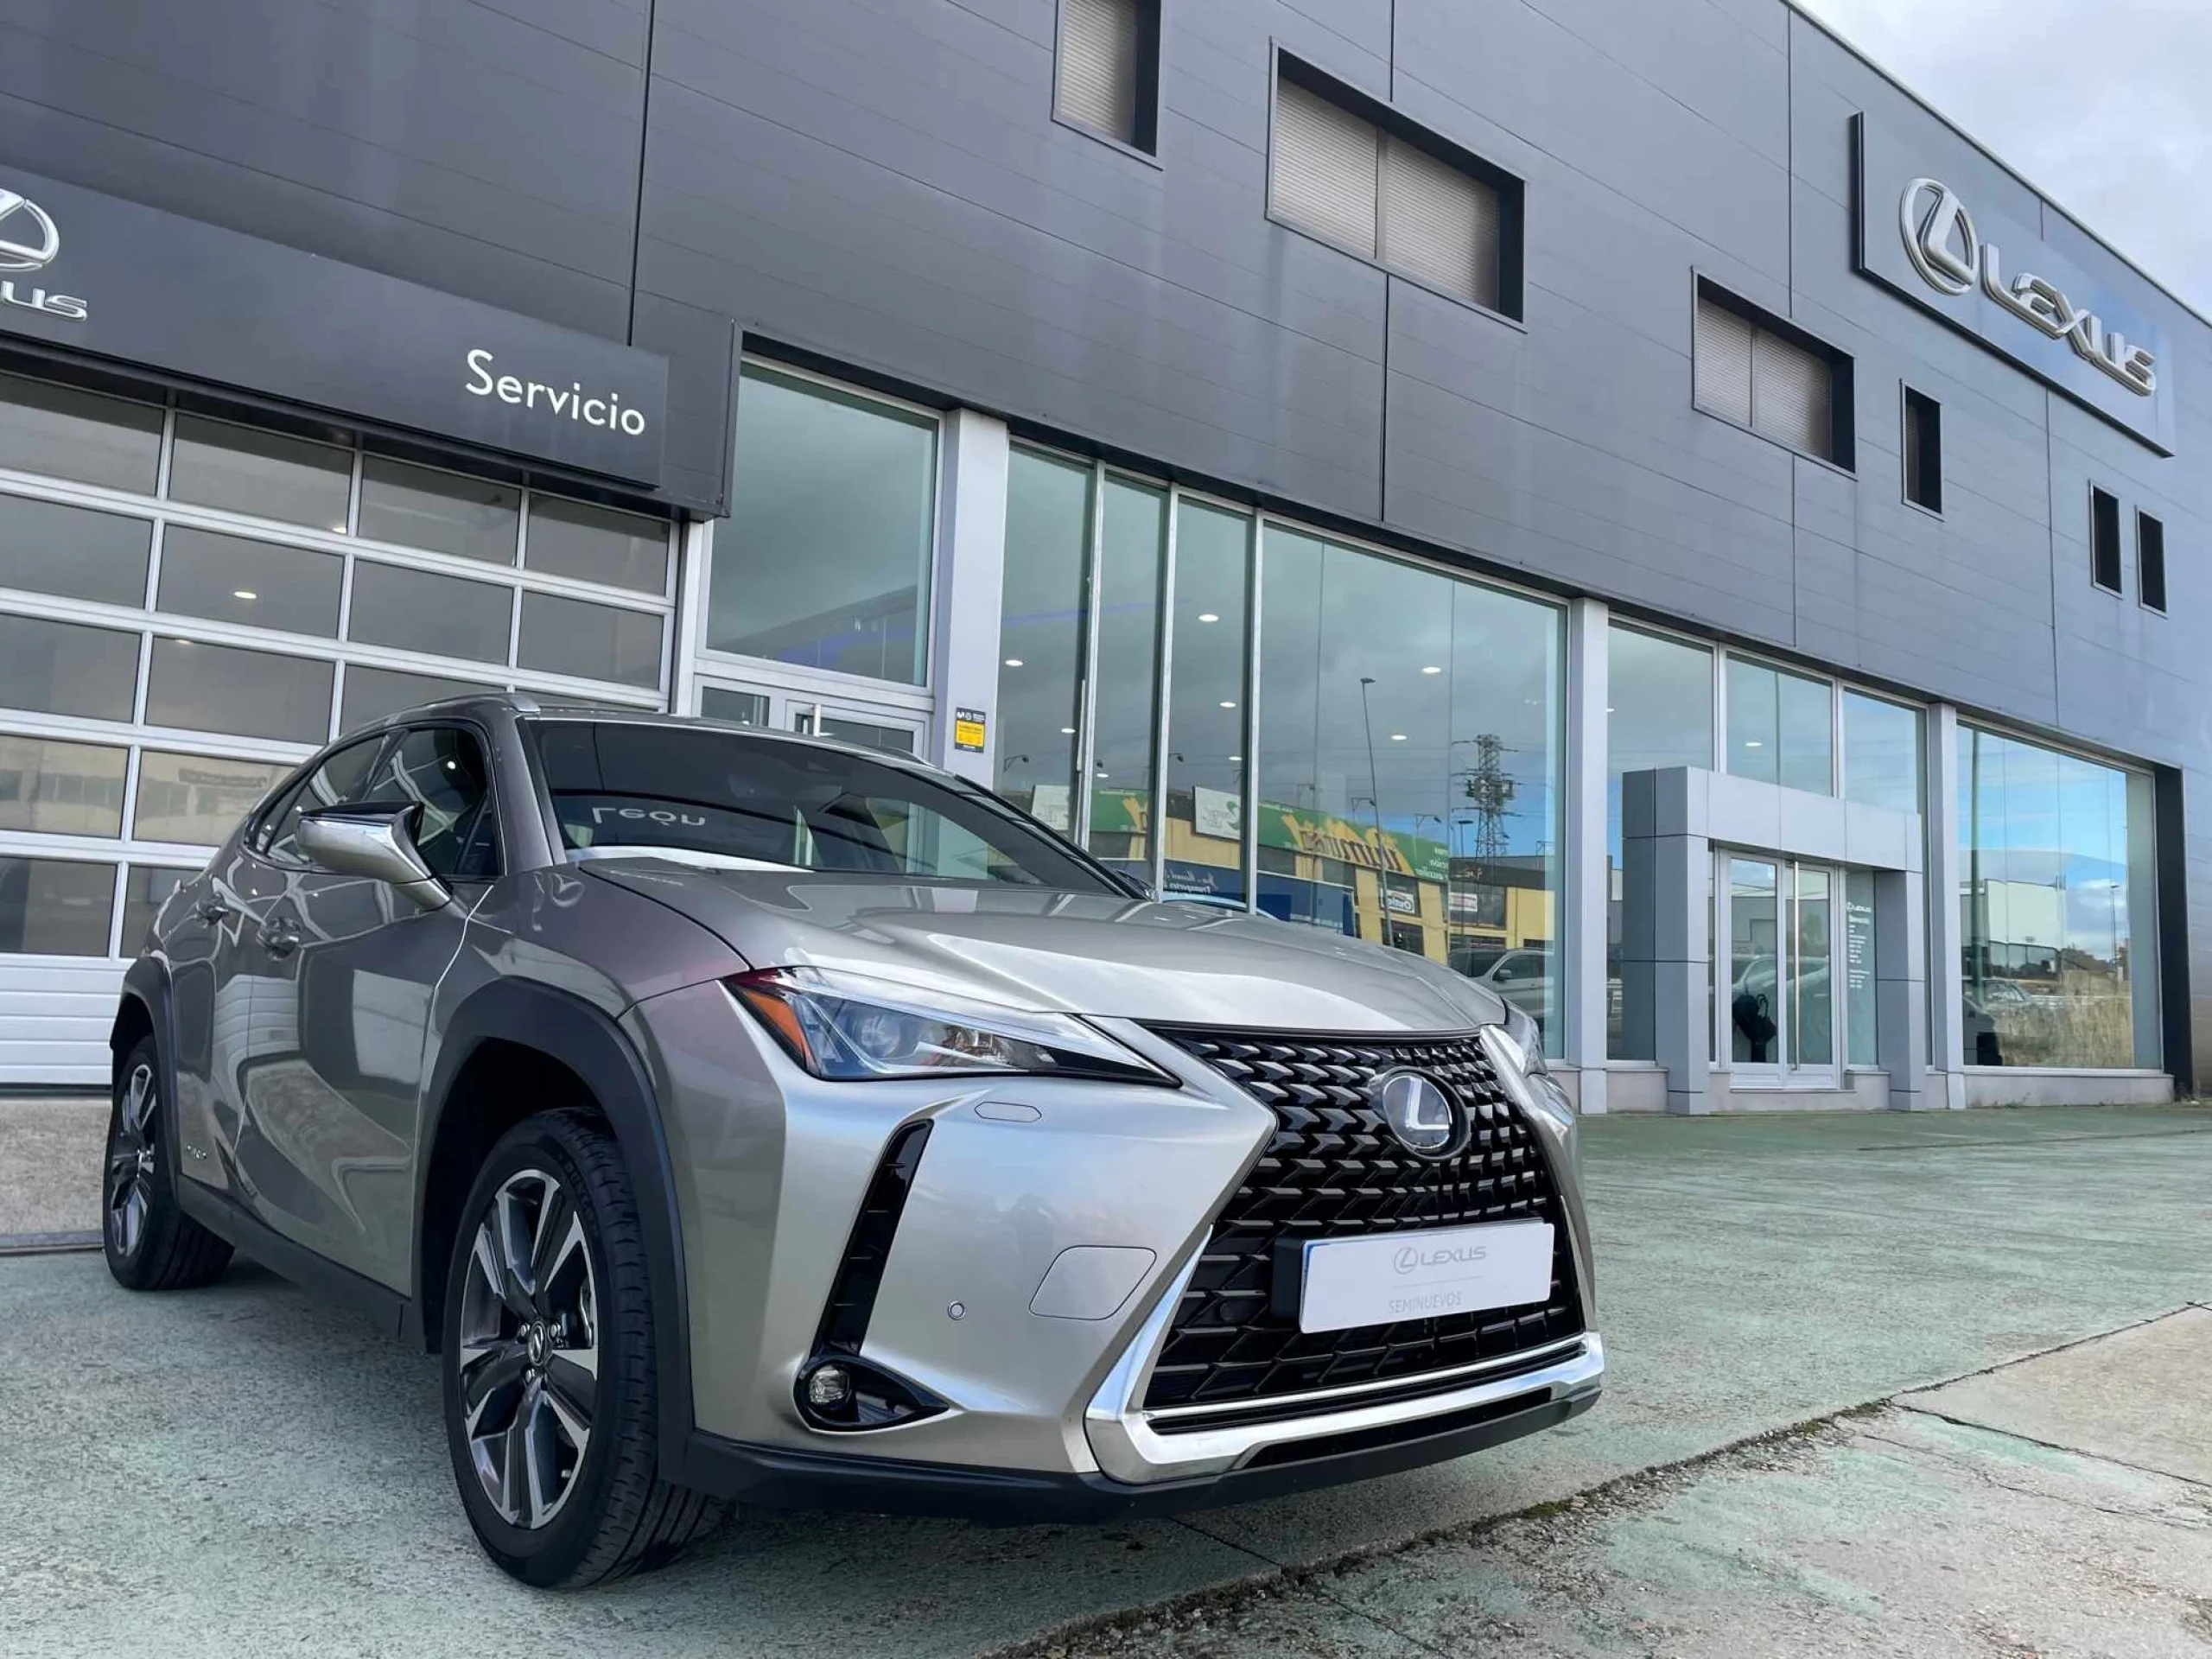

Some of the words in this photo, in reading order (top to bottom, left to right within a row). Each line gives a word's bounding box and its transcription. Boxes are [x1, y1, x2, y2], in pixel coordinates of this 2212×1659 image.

[1980, 244, 2157, 397] LEXUS
[465, 347, 647, 436] Servicio
[1420, 1245, 1487, 1267] LEXUS
[1388, 1292, 1462, 1313] SEMINUEVOS
